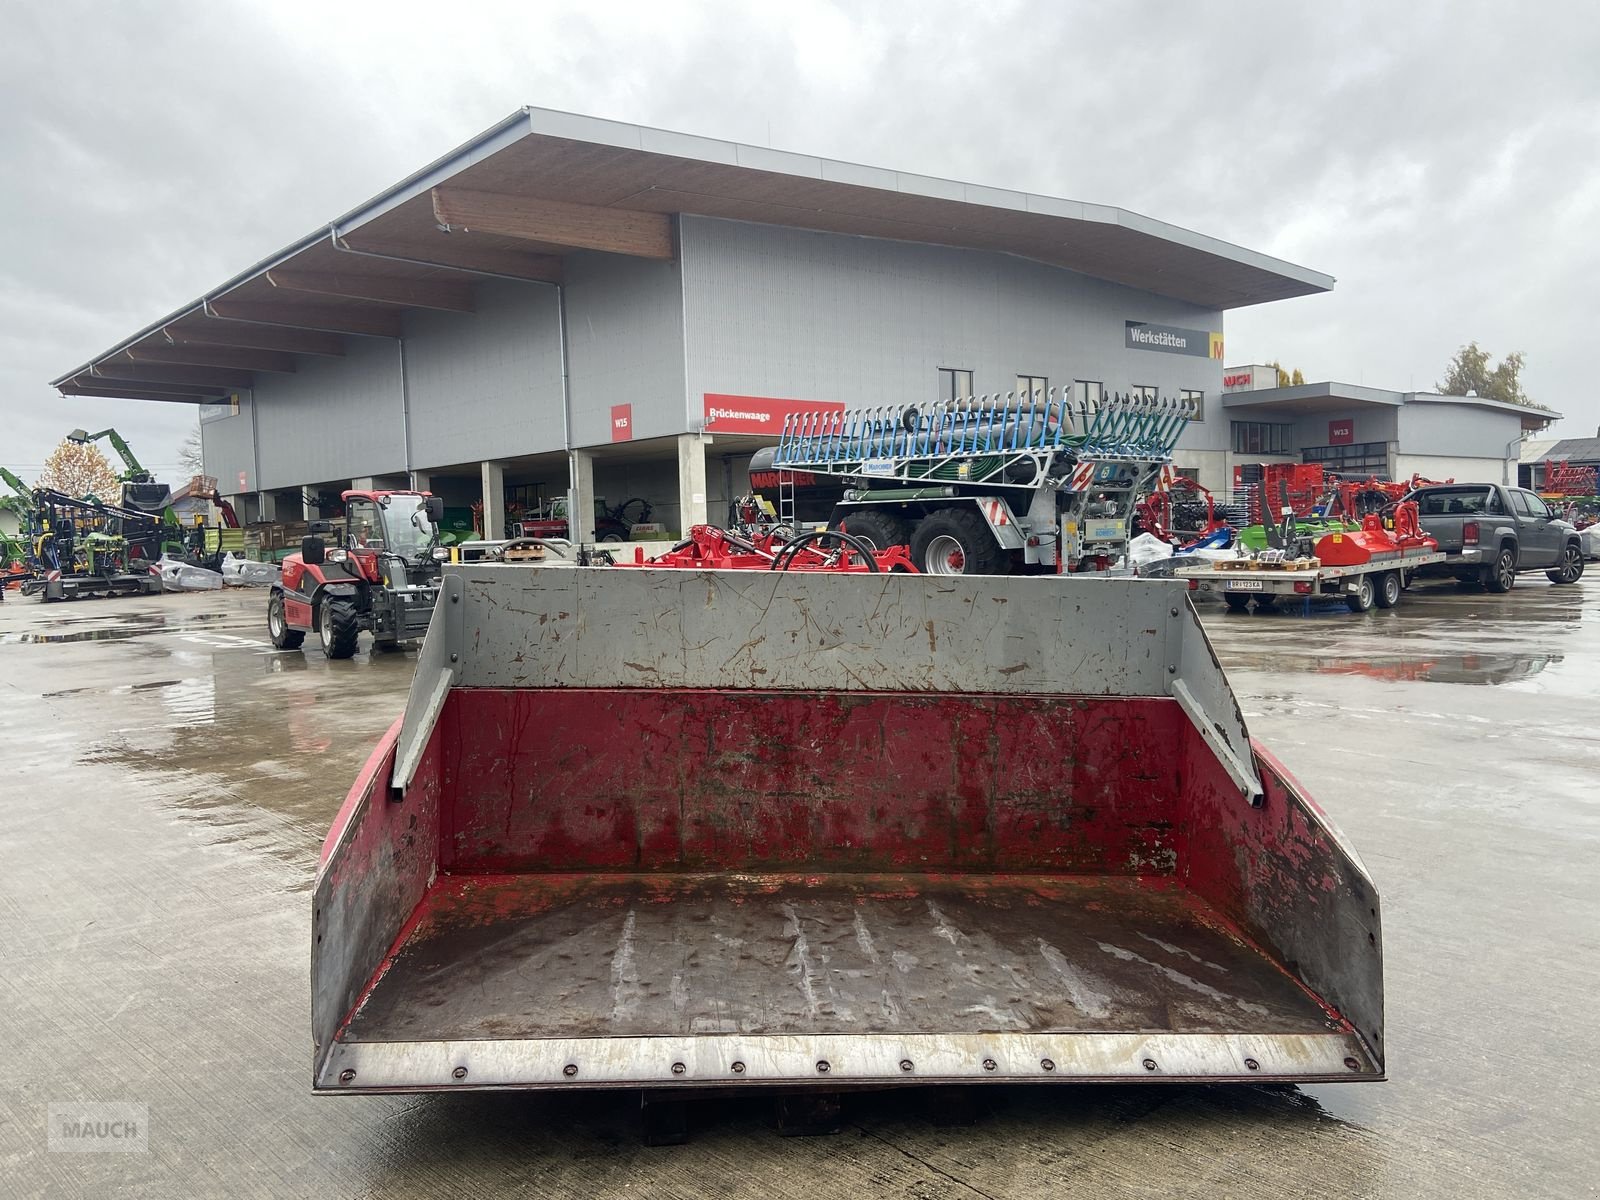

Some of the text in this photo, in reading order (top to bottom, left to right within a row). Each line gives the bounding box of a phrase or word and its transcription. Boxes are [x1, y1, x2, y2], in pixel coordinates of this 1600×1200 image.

[1131, 328, 1186, 348] Werkstätten
[709, 407, 770, 421] Brückenwaage
[614, 417, 628, 429] W15
[1333, 428, 1349, 436] W13
